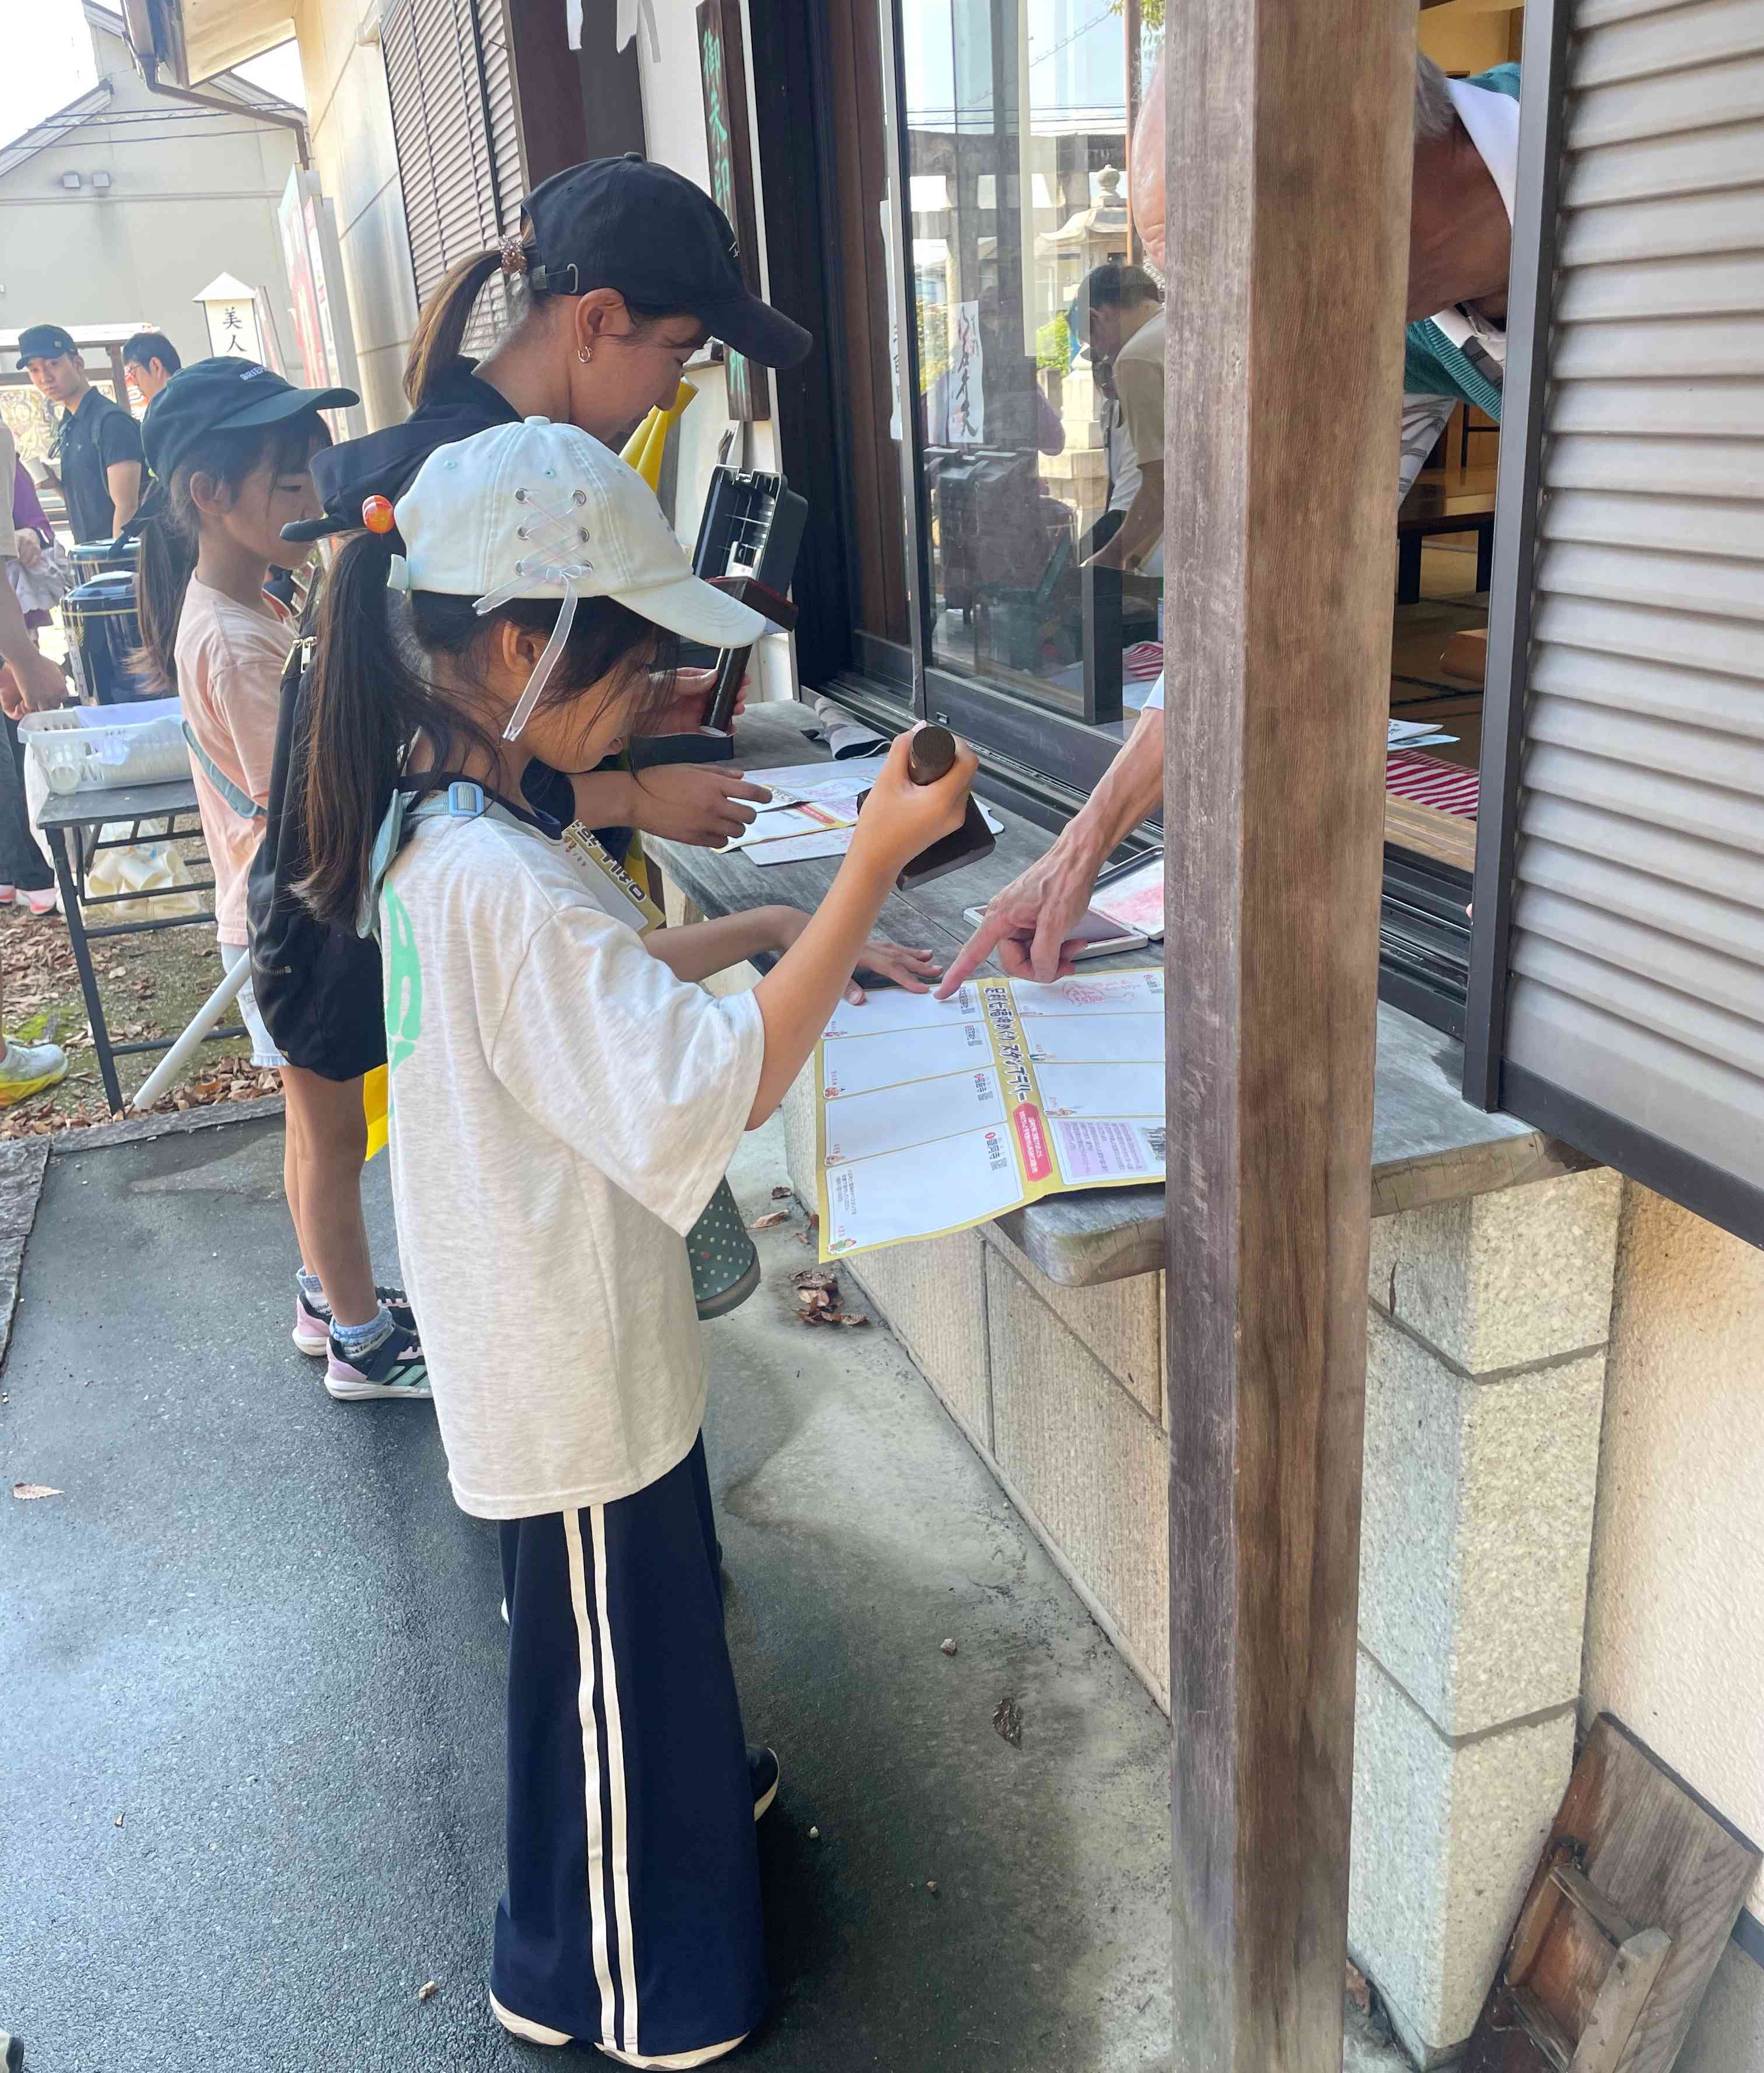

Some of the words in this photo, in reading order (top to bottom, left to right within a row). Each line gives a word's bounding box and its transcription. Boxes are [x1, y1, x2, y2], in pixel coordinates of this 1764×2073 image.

[222, 306, 247, 353] 美人
[998, 1043, 1032, 1102] スタンプラリー
